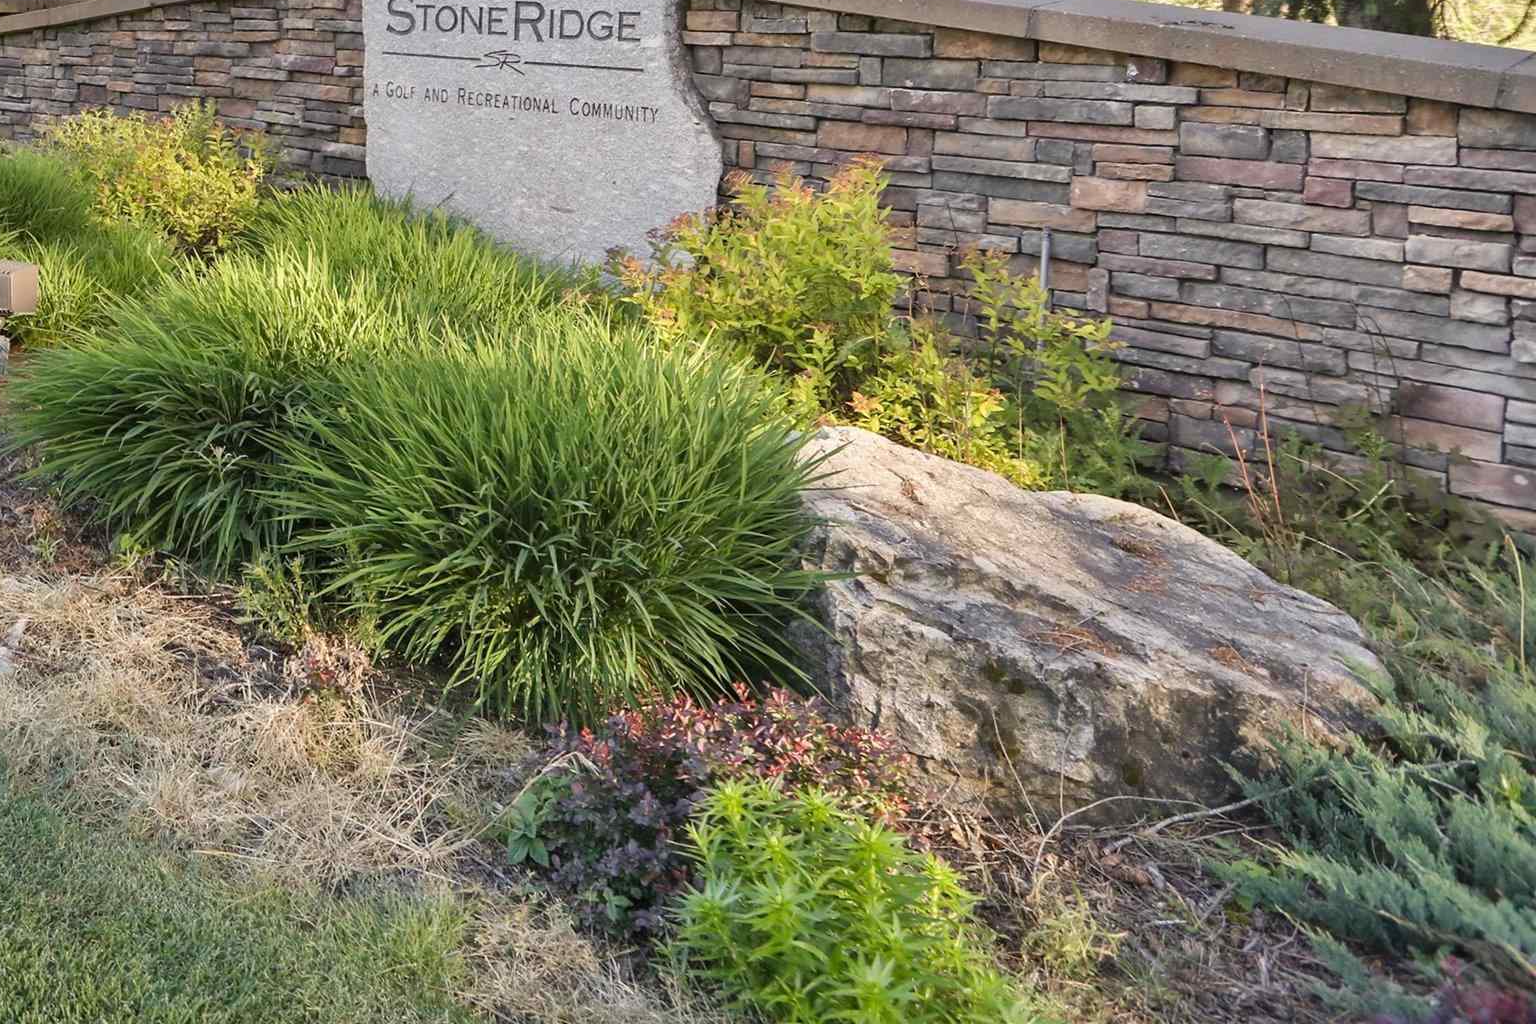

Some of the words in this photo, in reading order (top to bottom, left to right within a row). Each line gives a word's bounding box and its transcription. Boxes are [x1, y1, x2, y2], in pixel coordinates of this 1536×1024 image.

[372, 83, 380, 97] A
[385, 80, 416, 100] GOLF
[423, 87, 449, 103] AND
[457, 87, 559, 115] RECREATIONAL
[568, 97, 659, 123] COMMUNITY
